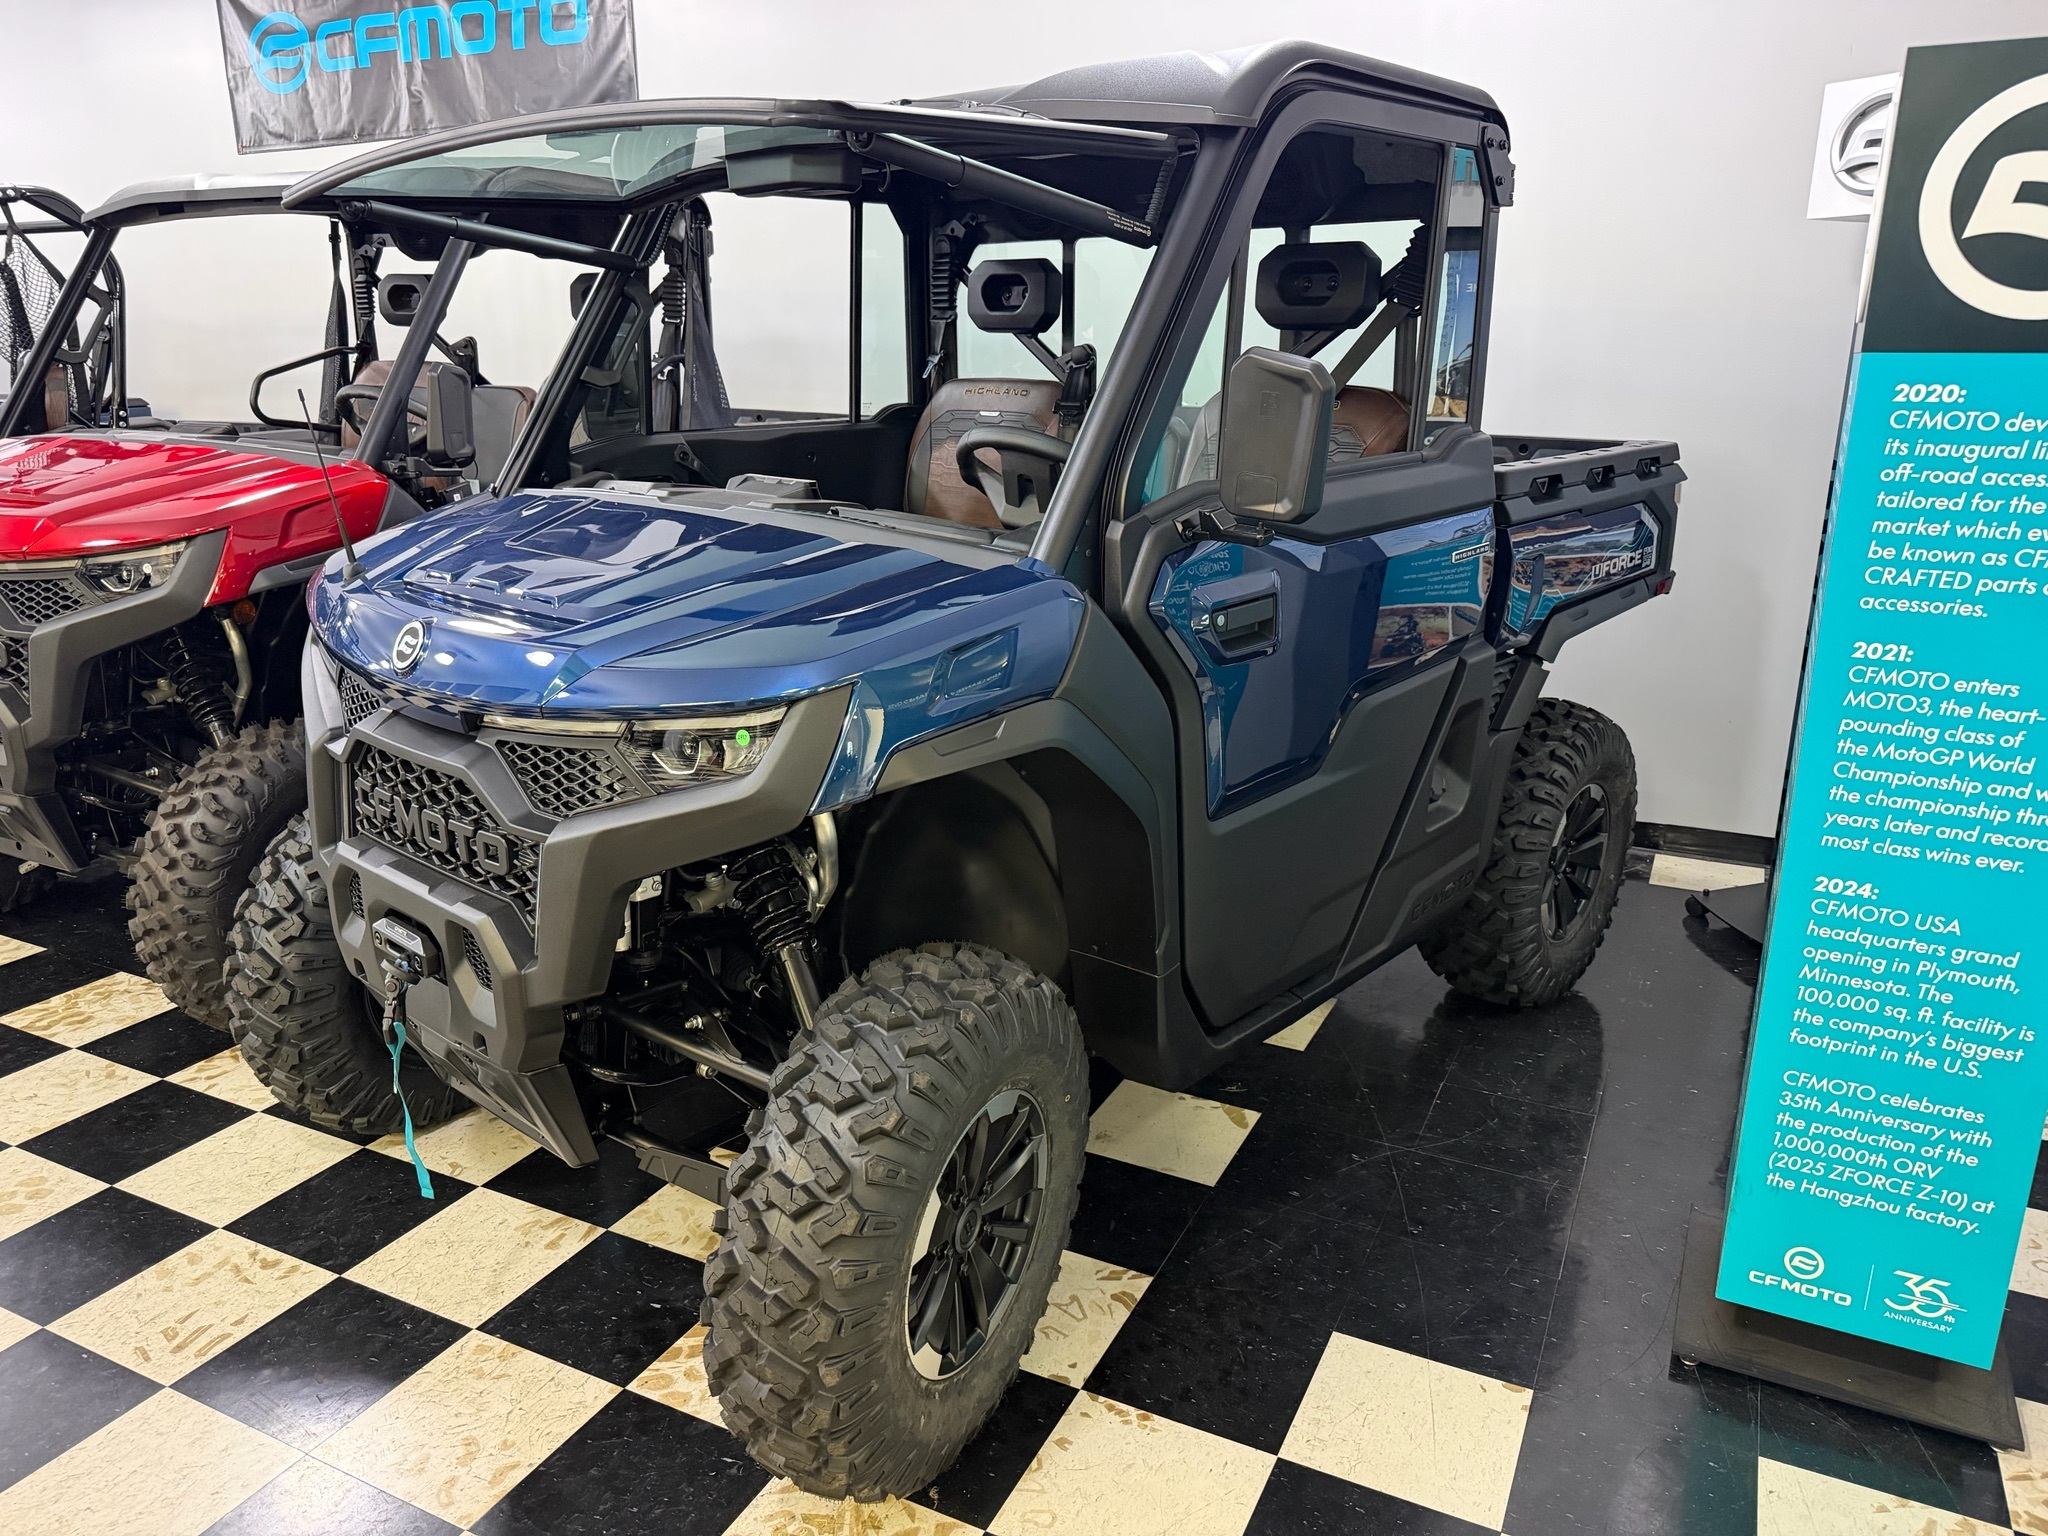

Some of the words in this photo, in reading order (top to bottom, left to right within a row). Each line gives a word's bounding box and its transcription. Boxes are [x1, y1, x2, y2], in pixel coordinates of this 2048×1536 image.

[315, 0, 591, 74] CFMOTO
[963, 387, 1031, 397] HIGHLAND
[1892, 383, 1967, 403] 2020:
[1890, 410, 2000, 431] CFMOTO
[1884, 438, 1909, 456] its
[1914, 439, 2030, 464] inaugural
[1880, 463, 1978, 484] off-road
[1981, 472, 2048, 487] acces
[1877, 490, 1967, 511] tailored
[1971, 492, 2005, 512] for
[2009, 494, 2047, 514] the
[1872, 517, 1951, 536] market
[1956, 519, 2021, 540] which
[1455, 545, 1489, 560] HIGHLAND
[1867, 540, 1896, 559] be
[1901, 542, 1975, 564] known
[1981, 553, 2008, 566] as
[1865, 566, 1972, 589] CRAFTED
[1975, 577, 2037, 596] parts
[1860, 597, 1987, 617] accessories.
[1851, 641, 1914, 662] 2021:
[1849, 665, 1950, 690] CFMOTO
[1954, 679, 2020, 697] enters
[1843, 690, 1933, 716] MOTO3,
[1939, 699, 1973, 718] the
[1977, 702, 2046, 724] heart-
[1838, 719, 1940, 745] pounding
[1944, 725, 1995, 745] class
[2000, 731, 2027, 748] of
[1837, 738, 1868, 756] the
[1872, 742, 1965, 766] MotoGP
[1968, 751, 2036, 775] World
[1833, 761, 1982, 797] Championship
[1987, 782, 2033, 799] and
[1829, 784, 1860, 803] the
[1865, 789, 2011, 826] championship
[356, 776, 512, 876] CFMOTO
[1823, 813, 1880, 829] years
[1884, 814, 1933, 836] later
[1936, 825, 1981, 842] and
[1821, 835, 1870, 851] most
[1872, 838, 1921, 859] class
[1926, 848, 1971, 865] wins
[1975, 856, 2024, 873] ever.
[1813, 876, 1879, 900] 2024:
[1811, 898, 1909, 927] CFMOTO
[1915, 914, 1960, 936] USA
[1806, 920, 1946, 956] headquarters
[1950, 948, 2021, 968] grand
[1799, 964, 1910, 997] Minnesota.
[1918, 983, 1953, 1004] The
[1803, 947, 1887, 974] opening
[1892, 958, 1910, 974] in
[1916, 961, 2020, 994] Plymouth,
[1798, 986, 1879, 1013] 100,000
[1883, 1006, 1911, 1023] sq.
[1917, 1006, 1935, 1024] ft.
[1942, 1011, 2016, 1041] facility
[2018, 1026, 2035, 1041] is
[1790, 1028, 1877, 1057] footprint
[1880, 1046, 1898, 1062] in
[1905, 1050, 1937, 1069] the
[1944, 1057, 1982, 1078] U.S.
[1793, 1007, 1824, 1026] the
[1829, 1018, 1937, 1047] company's
[1941, 1033, 2024, 1062] biggest
[1783, 1070, 1876, 1100] CFMOTO
[1880, 1093, 1985, 1123] celebrates
[1779, 1091, 1821, 1112] 35th
[1824, 1101, 1946, 1141] Anniversary
[1950, 1130, 1992, 1148] with
[1774, 1131, 1887, 1169] 1,000,000th
[1893, 1158, 1943, 1179] ORV
[1776, 1112, 1806, 1130] the
[1808, 1123, 1916, 1154] production
[1921, 1144, 1945, 1159] of
[1946, 1148, 1978, 1166] the
[1769, 1151, 1826, 1176] (2025
[1828, 1164, 1915, 1196] ZFORCE
[1916, 1184, 1968, 1212] Z-10)
[1972, 1201, 1995, 1214] at
[1766, 1172, 1795, 1190] the
[1800, 1179, 1901, 1214] Hangzhou
[1906, 1203, 1979, 1235] factory.
[1748, 1270, 1852, 1307] CFMOTO
[1883, 1310, 1953, 1334] ANNIVERSARY
